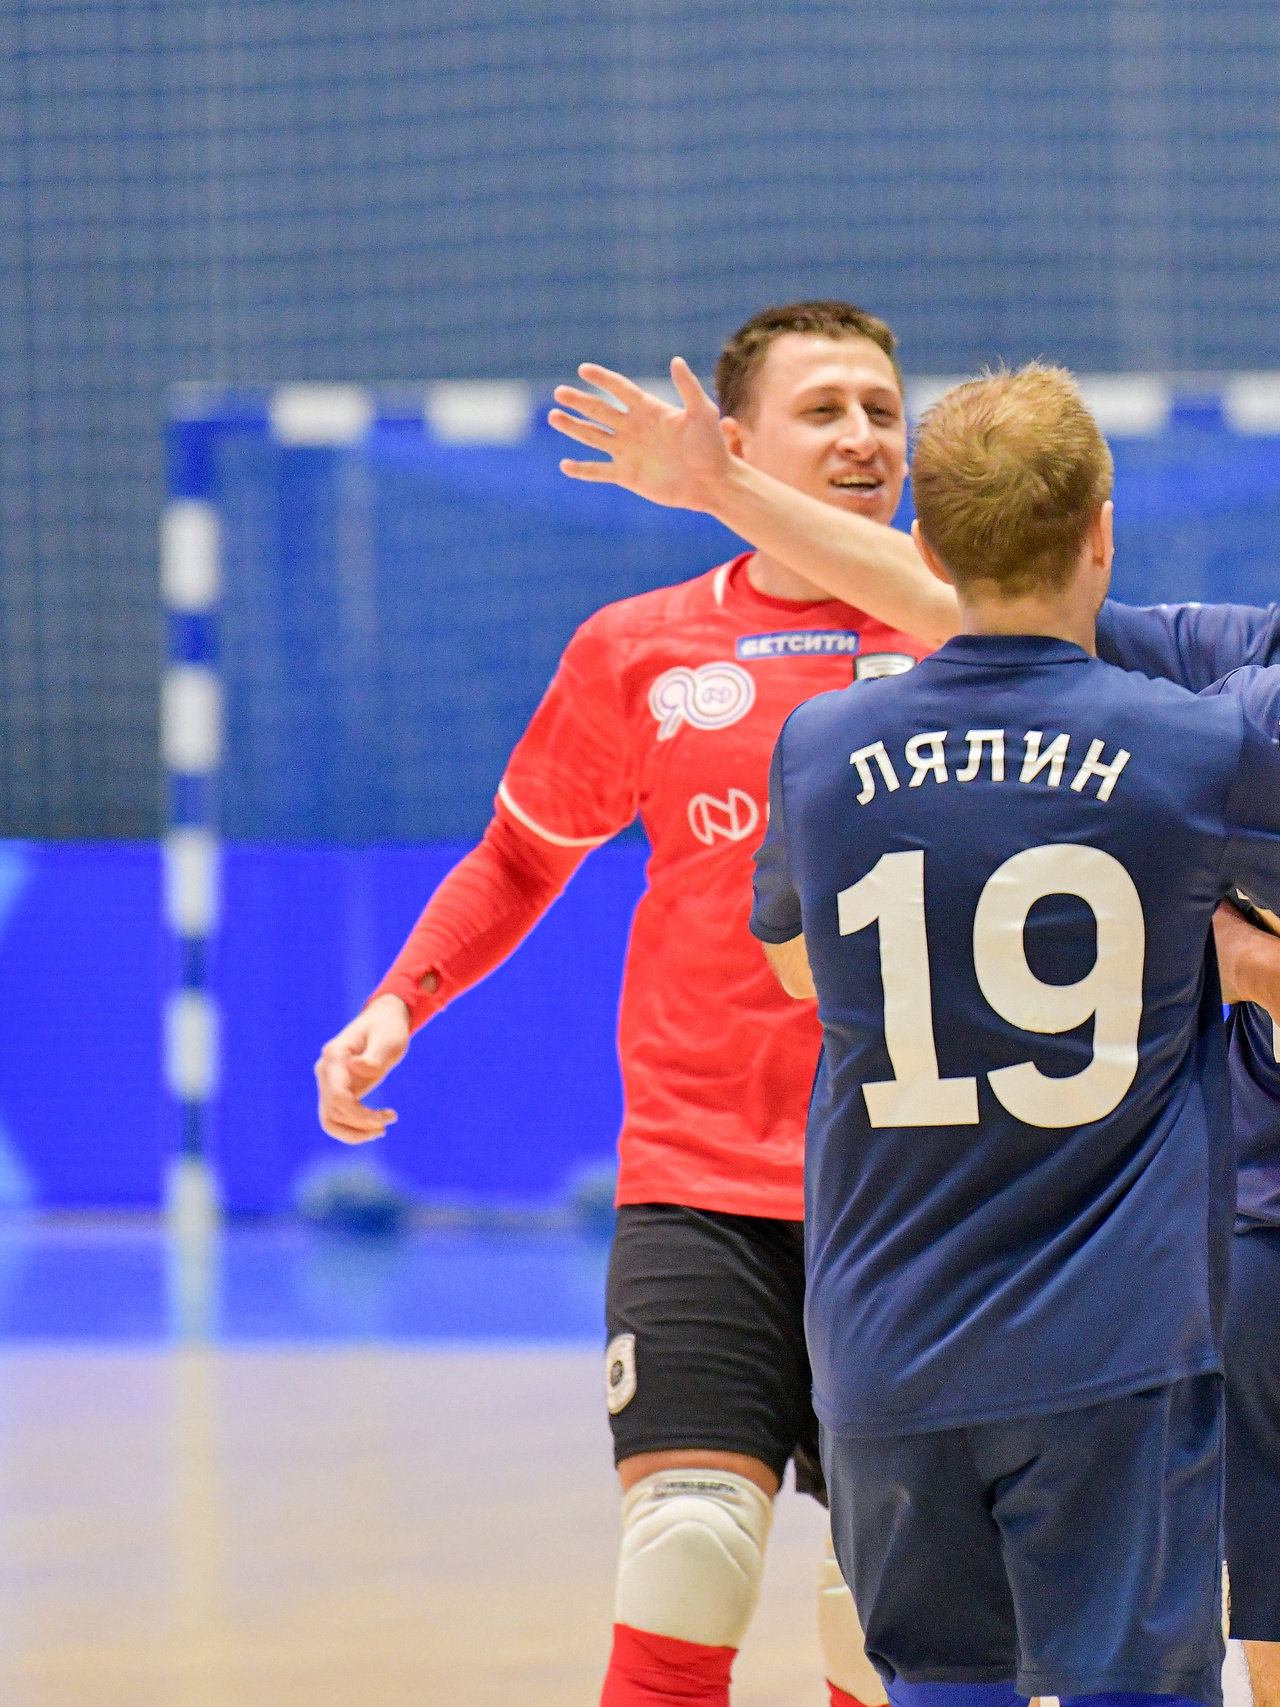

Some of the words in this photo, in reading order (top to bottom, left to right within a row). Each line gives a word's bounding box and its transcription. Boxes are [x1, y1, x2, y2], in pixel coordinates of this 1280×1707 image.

[740, 635, 856, 656] БЕТСИТИ
[849, 729, 1131, 806] ЛЯЛИН
[837, 843, 1146, 1129] 19
